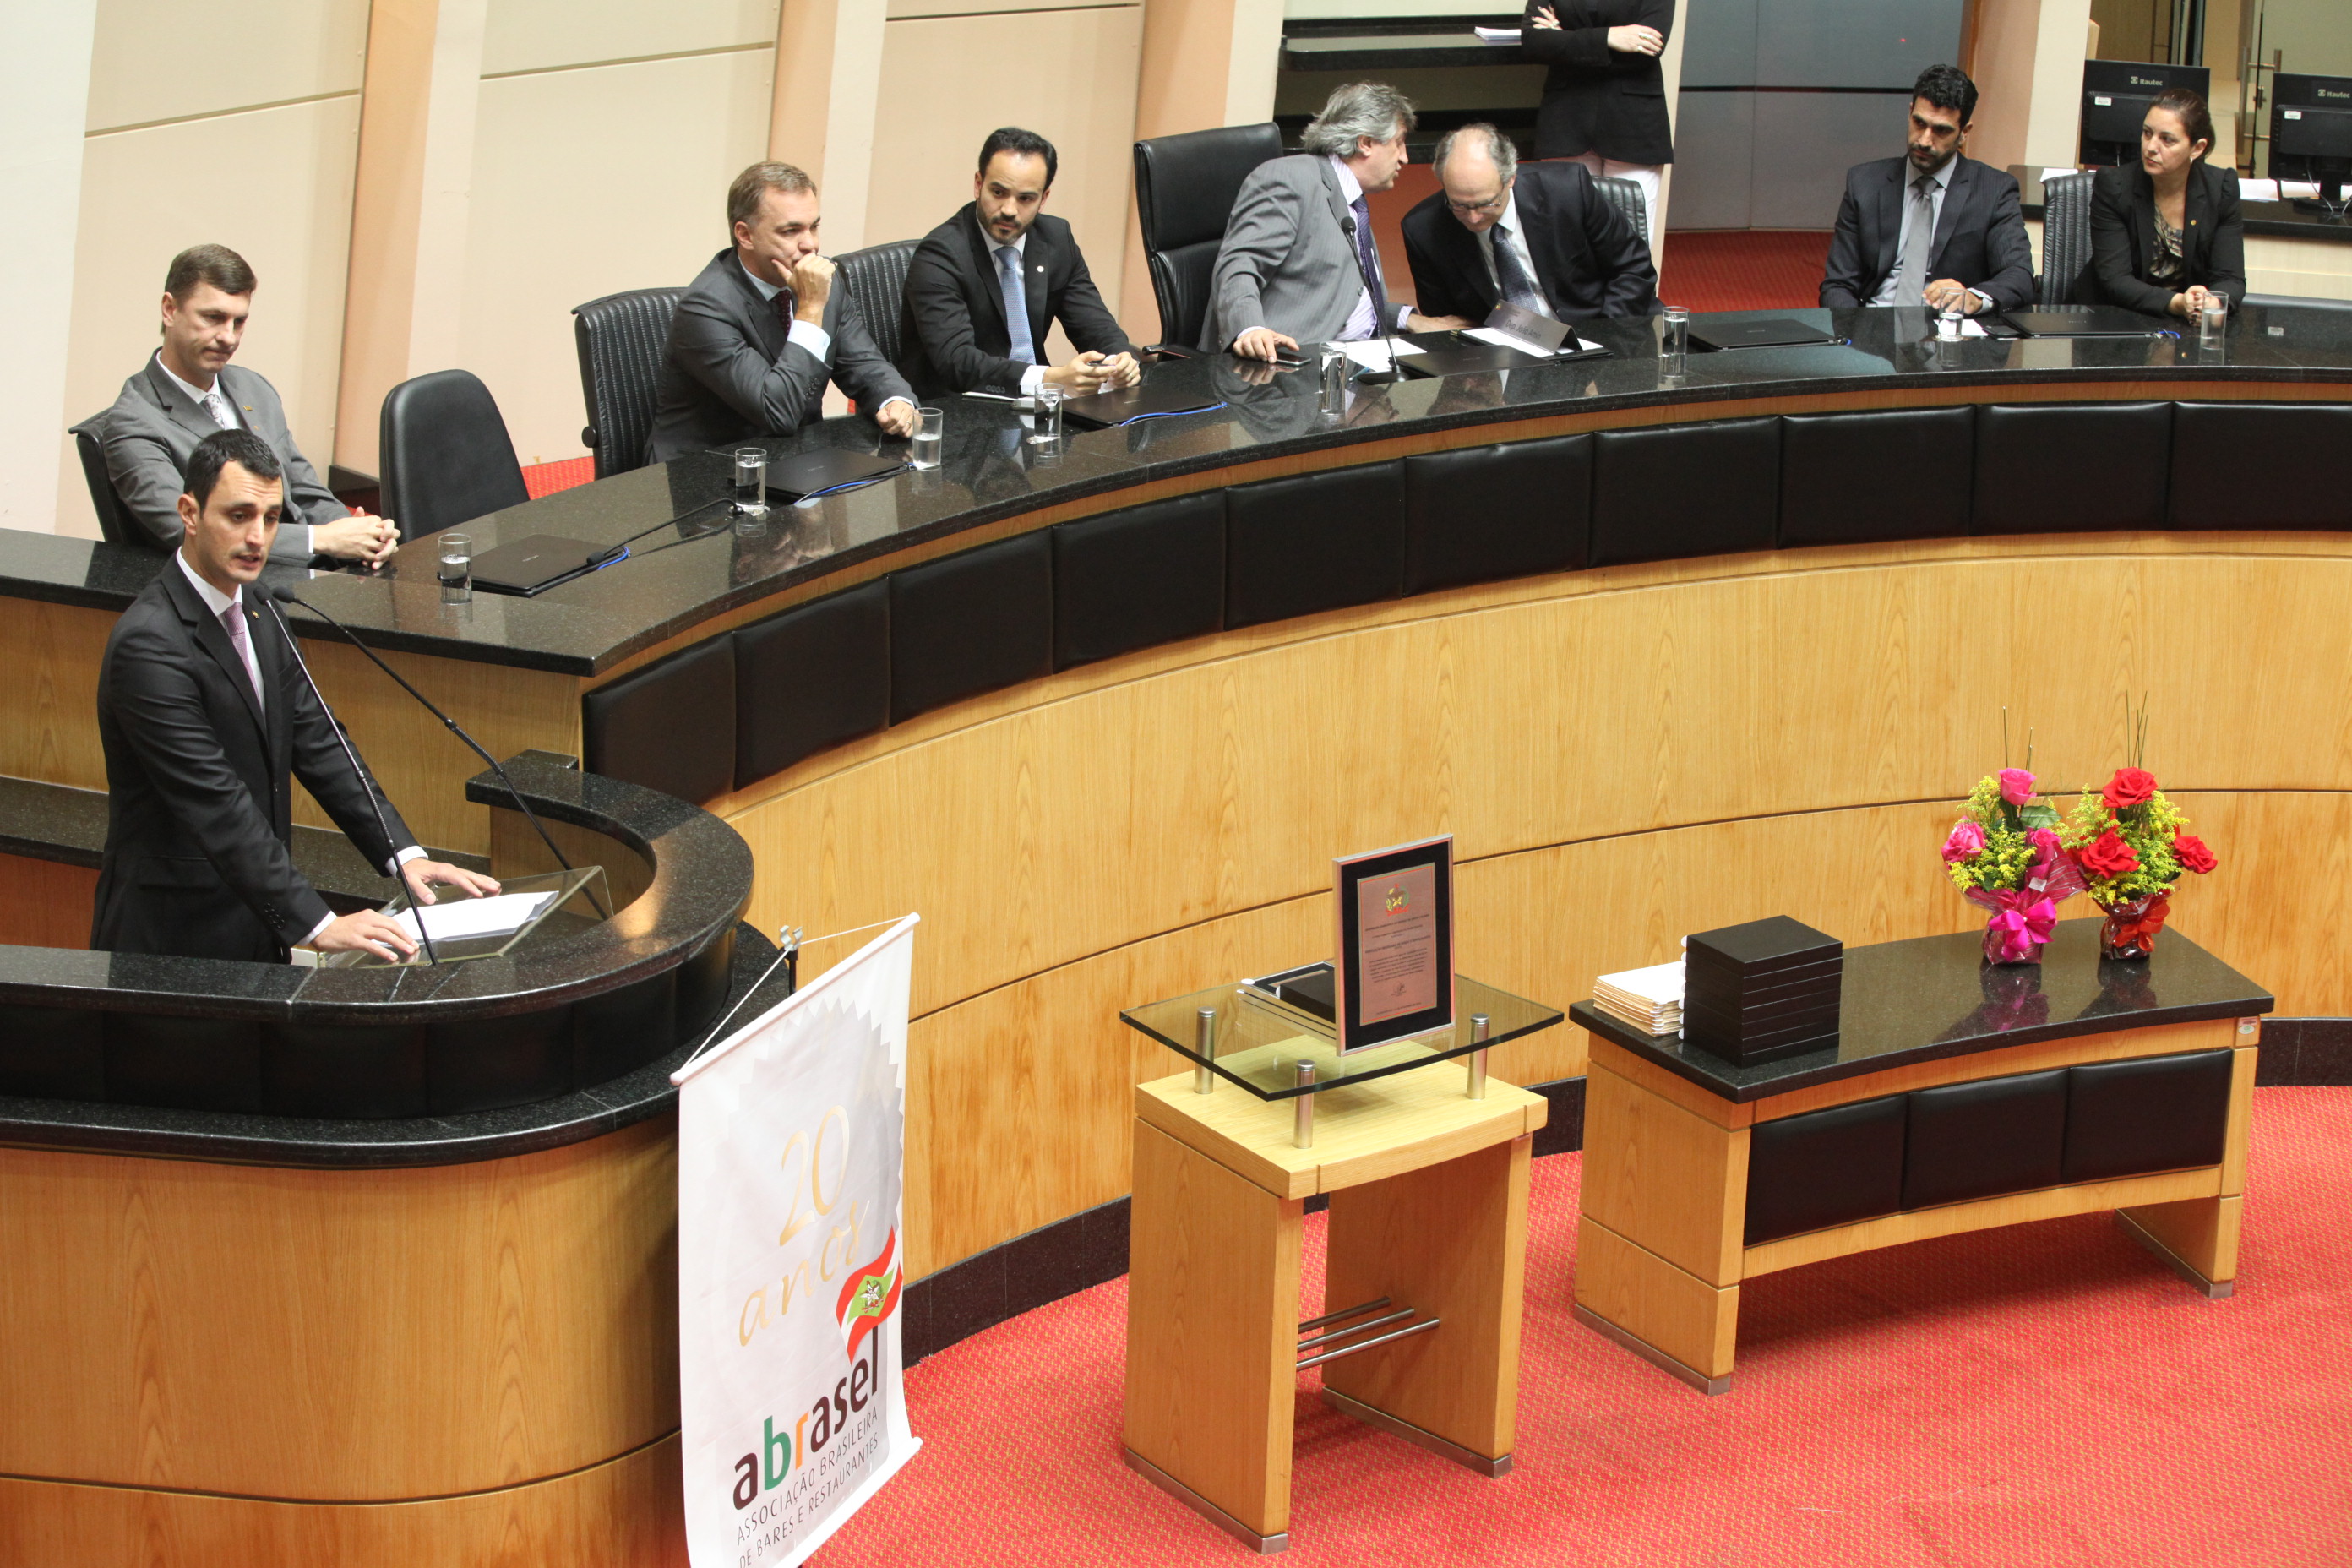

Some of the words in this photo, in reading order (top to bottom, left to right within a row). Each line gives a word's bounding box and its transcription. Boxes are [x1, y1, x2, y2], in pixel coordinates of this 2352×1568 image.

[2327, 90, 2350, 99] Itautec
[779, 1104, 850, 1247] 20
[739, 1200, 870, 1347] anos
[732, 1326, 879, 1511] abrasel
[738, 1468, 815, 1546] ASSOCIAÇÃO
[820, 1405, 878, 1476] BRASILEIRA
[739, 1549, 752, 1568] DE
[756, 1516, 794, 1558] BARES
[798, 1505, 803, 1523] E
[808, 1432, 878, 1515] RESTAURANTES
